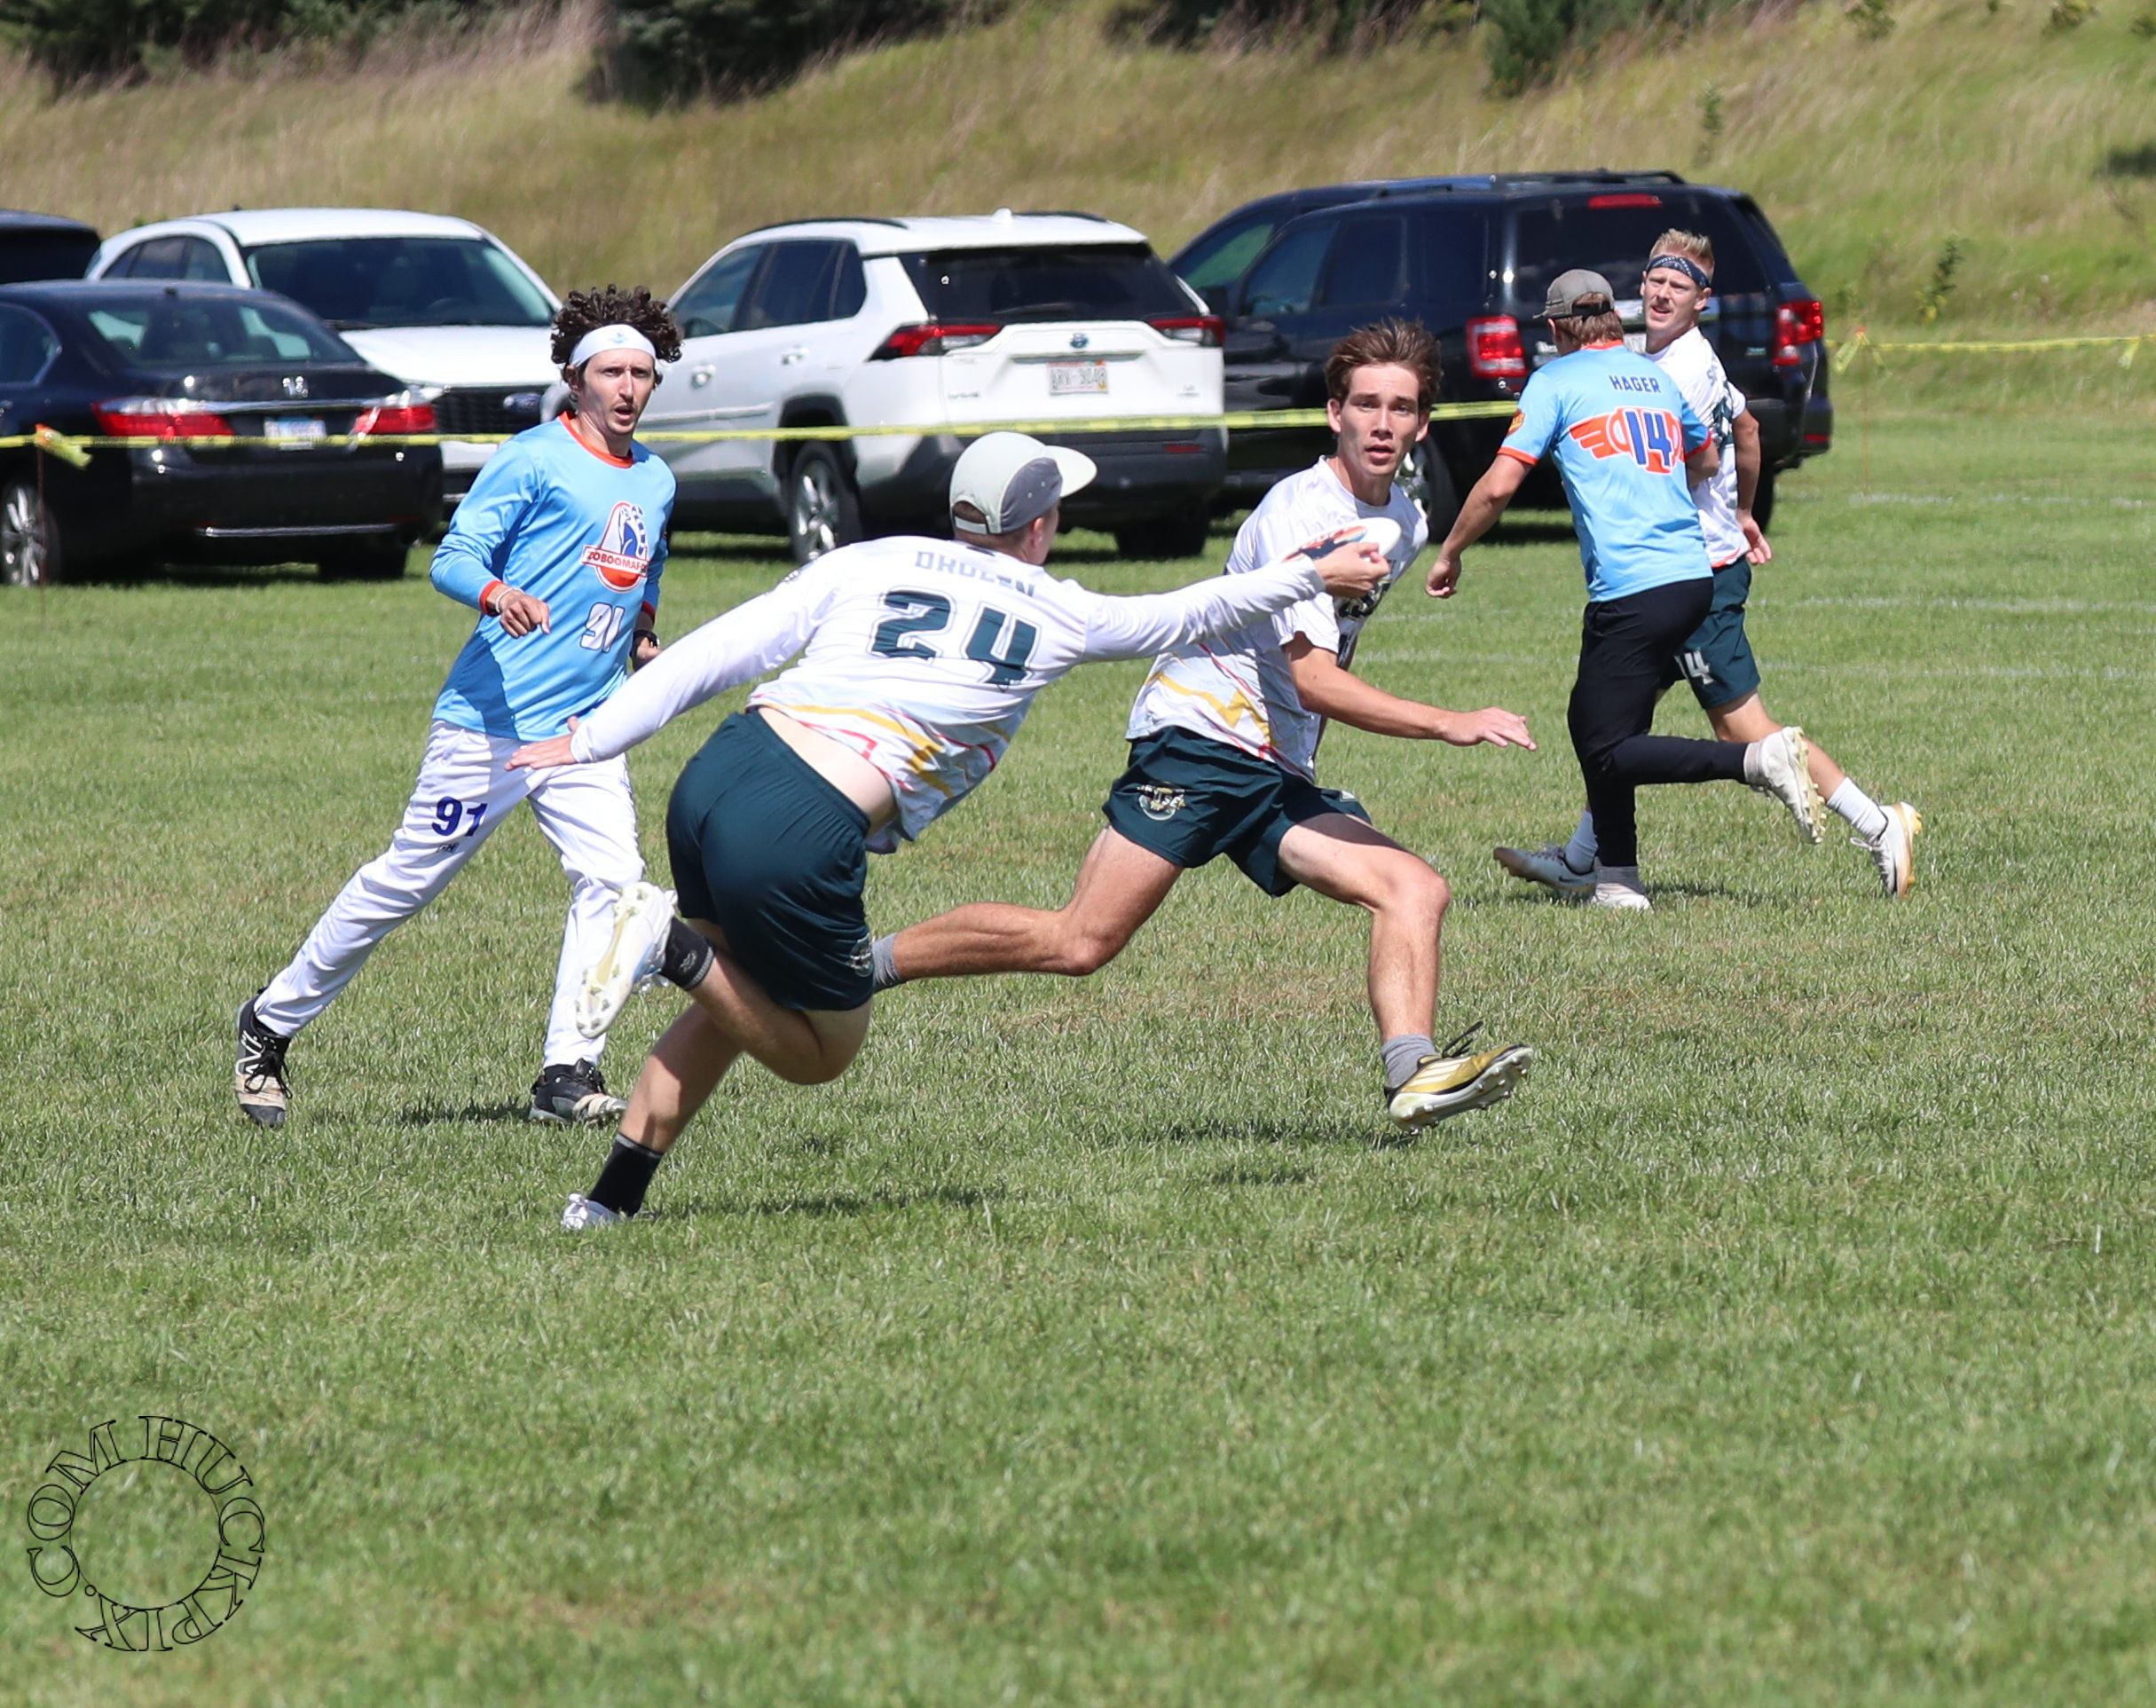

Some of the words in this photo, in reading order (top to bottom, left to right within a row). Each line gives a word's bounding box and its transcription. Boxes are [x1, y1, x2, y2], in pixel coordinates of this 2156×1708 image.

[1609, 374, 1661, 393] HAGER
[1623, 410, 1674, 468] 14
[579, 601, 626, 654] 91
[869, 587, 1039, 686] 24
[431, 795, 489, 837] 91
